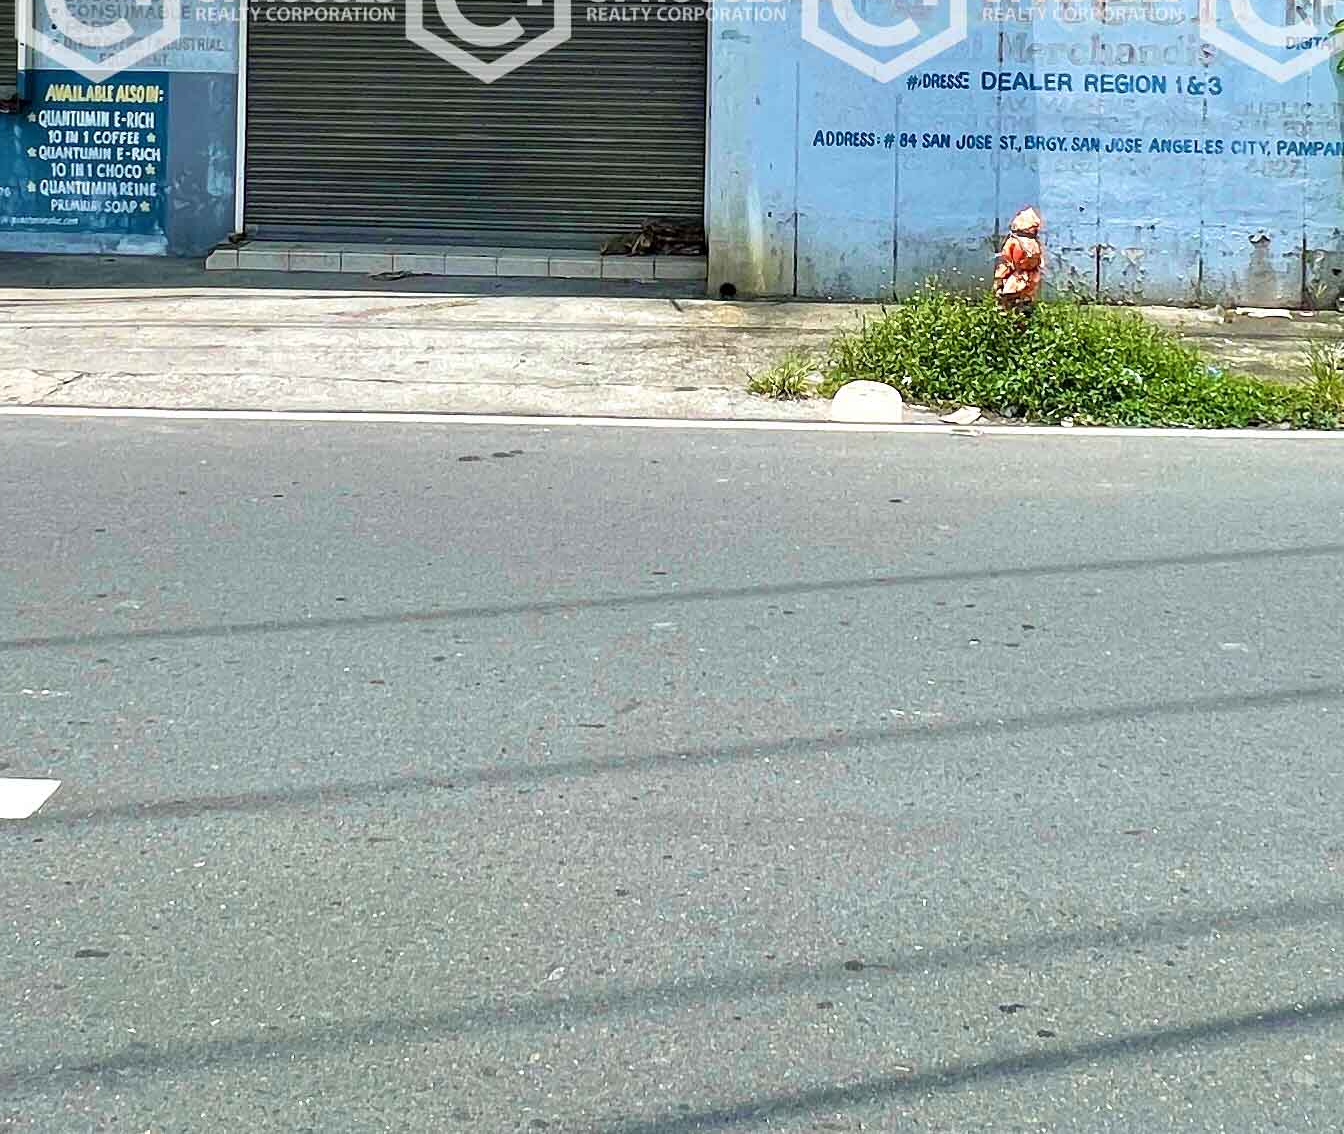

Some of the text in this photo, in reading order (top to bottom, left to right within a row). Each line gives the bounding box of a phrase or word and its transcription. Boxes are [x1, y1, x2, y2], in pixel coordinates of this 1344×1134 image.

[981, 72, 1073, 92] DEALER
[1084, 74, 1167, 94] REGION
[45, 84, 114, 102] AVAILABLE
[115, 85, 145, 103] ALSO
[38, 110, 155, 129] QUANTUMIN E-RICH
[48, 130, 140, 145] 10 IN 1 COFFEE
[813, 130, 880, 147] ADDRESS:
[899, 133, 917, 148] 84
[922, 133, 950, 149] SAN
[956, 135, 993, 150] JOSE
[1071, 137, 1100, 152] SAN
[1106, 138, 1143, 154] JOSE
[1148, 138, 1224, 155] ANGELES
[1231, 140, 1271, 156] CITY,
[39, 146, 111, 160] QUANTUMIN
[51, 163, 142, 178] 10 IN 1 CHOCO
[104, 200, 138, 213] SOAP
